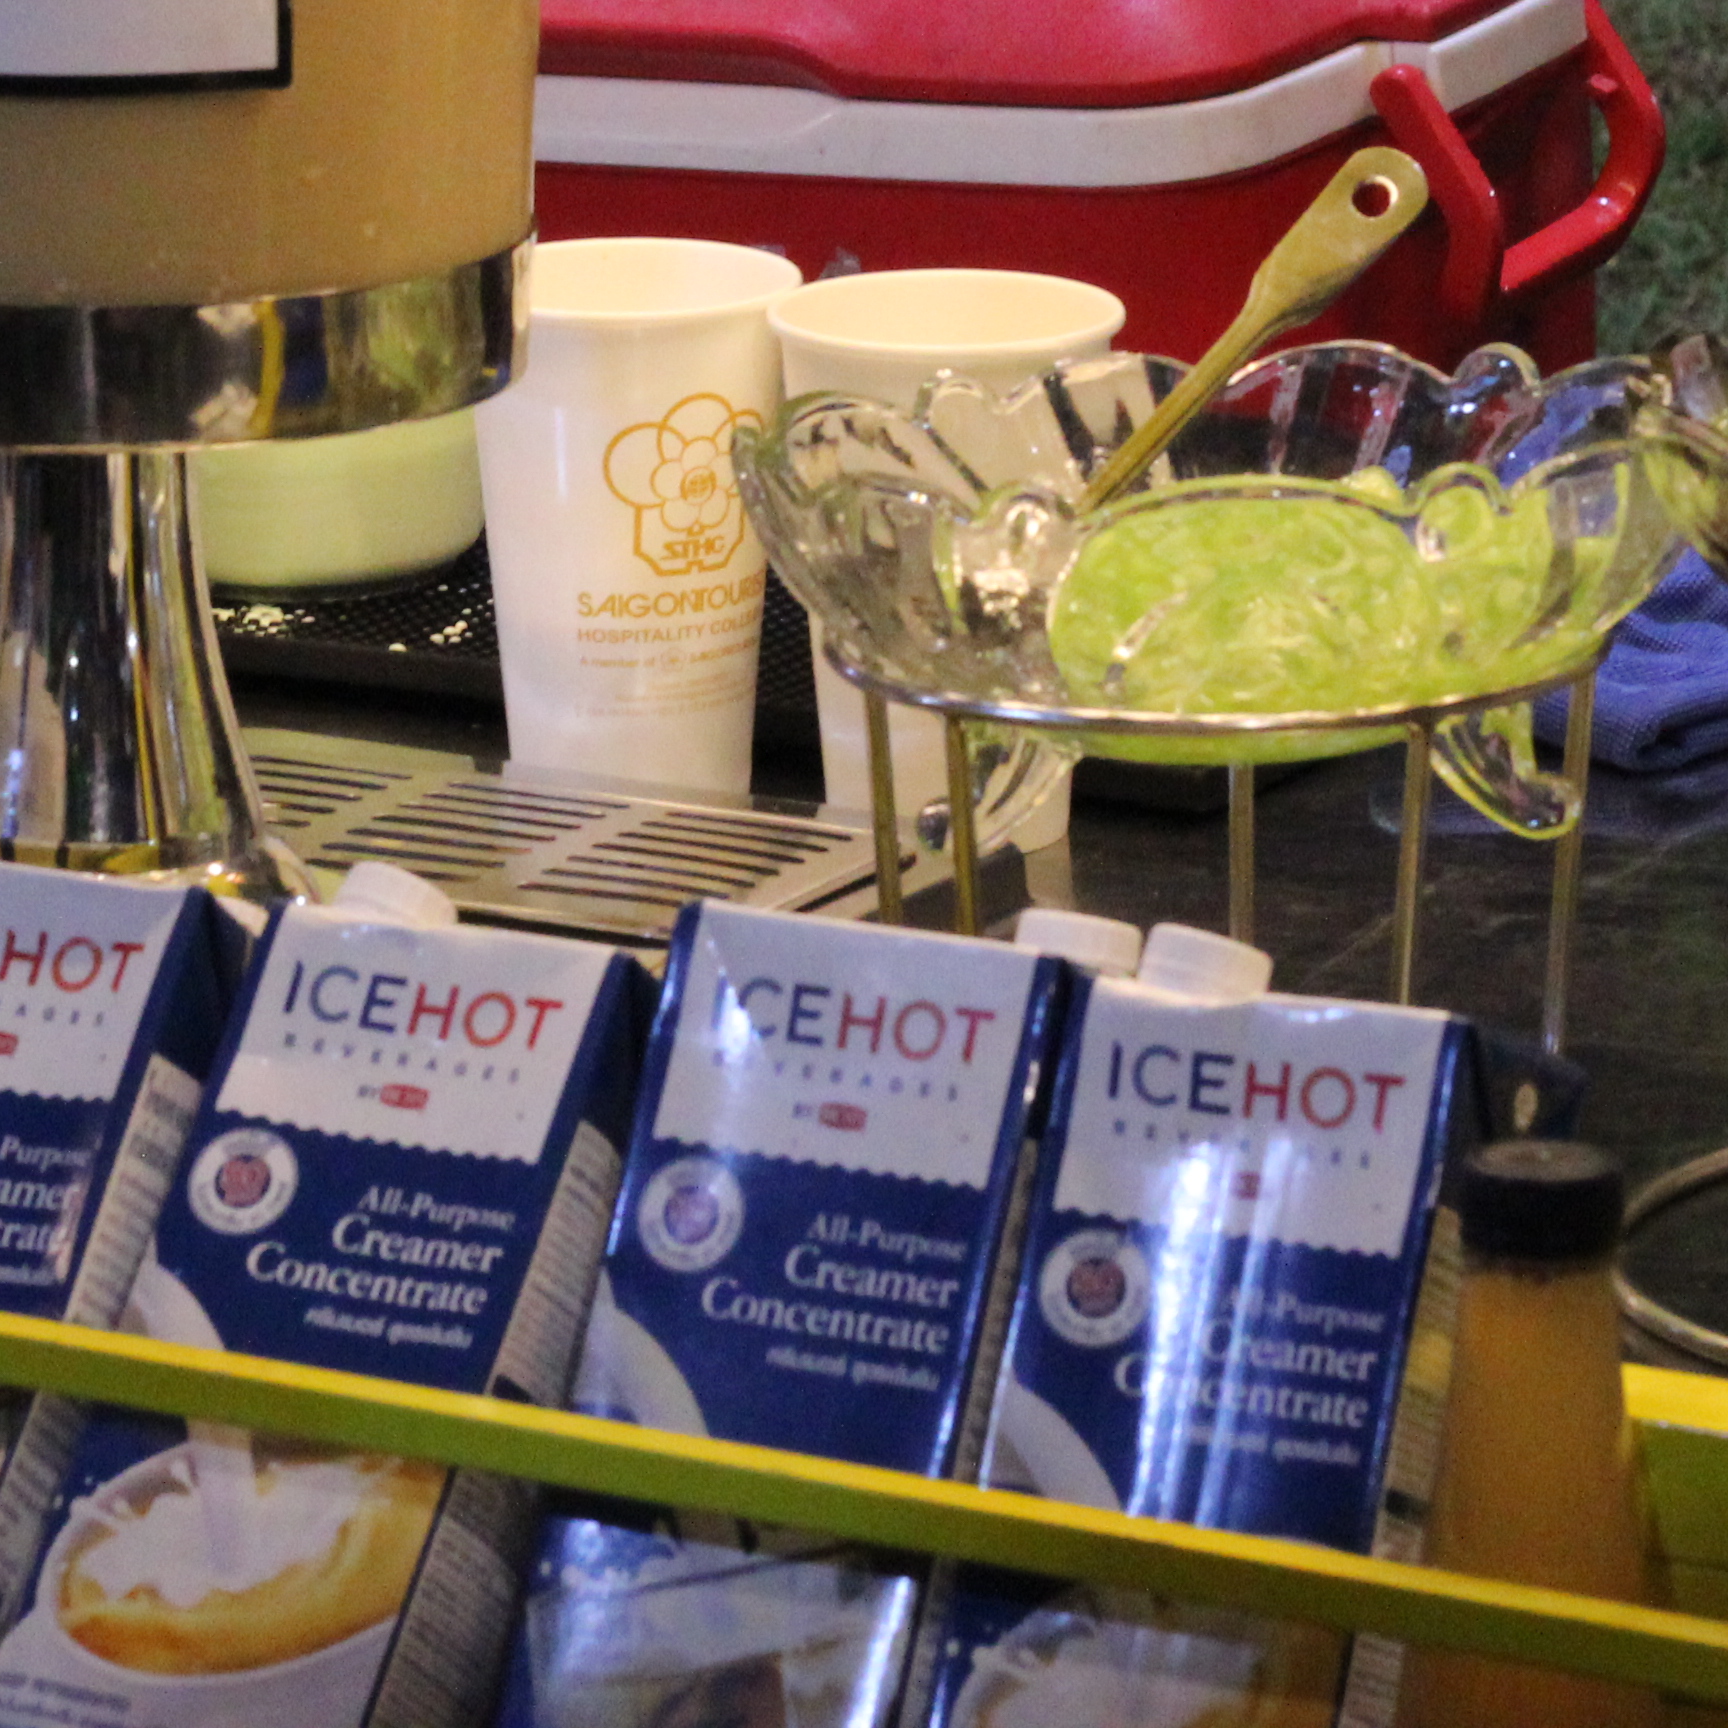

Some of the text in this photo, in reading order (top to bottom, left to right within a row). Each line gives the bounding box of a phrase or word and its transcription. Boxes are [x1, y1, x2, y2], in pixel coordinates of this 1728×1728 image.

[578, 623, 705, 645] HOSPITALITY
[282, 960, 564, 1051] ICEHOT
[1106, 1041, 1406, 1133] ICEHOT
[331, 1213, 504, 1274] Creamer
[807, 1212, 969, 1263] All-Purpose
[245, 1241, 489, 1316] Concentrate
[784, 1243, 959, 1310] Creamer
[700, 1275, 951, 1355] Concentrate
